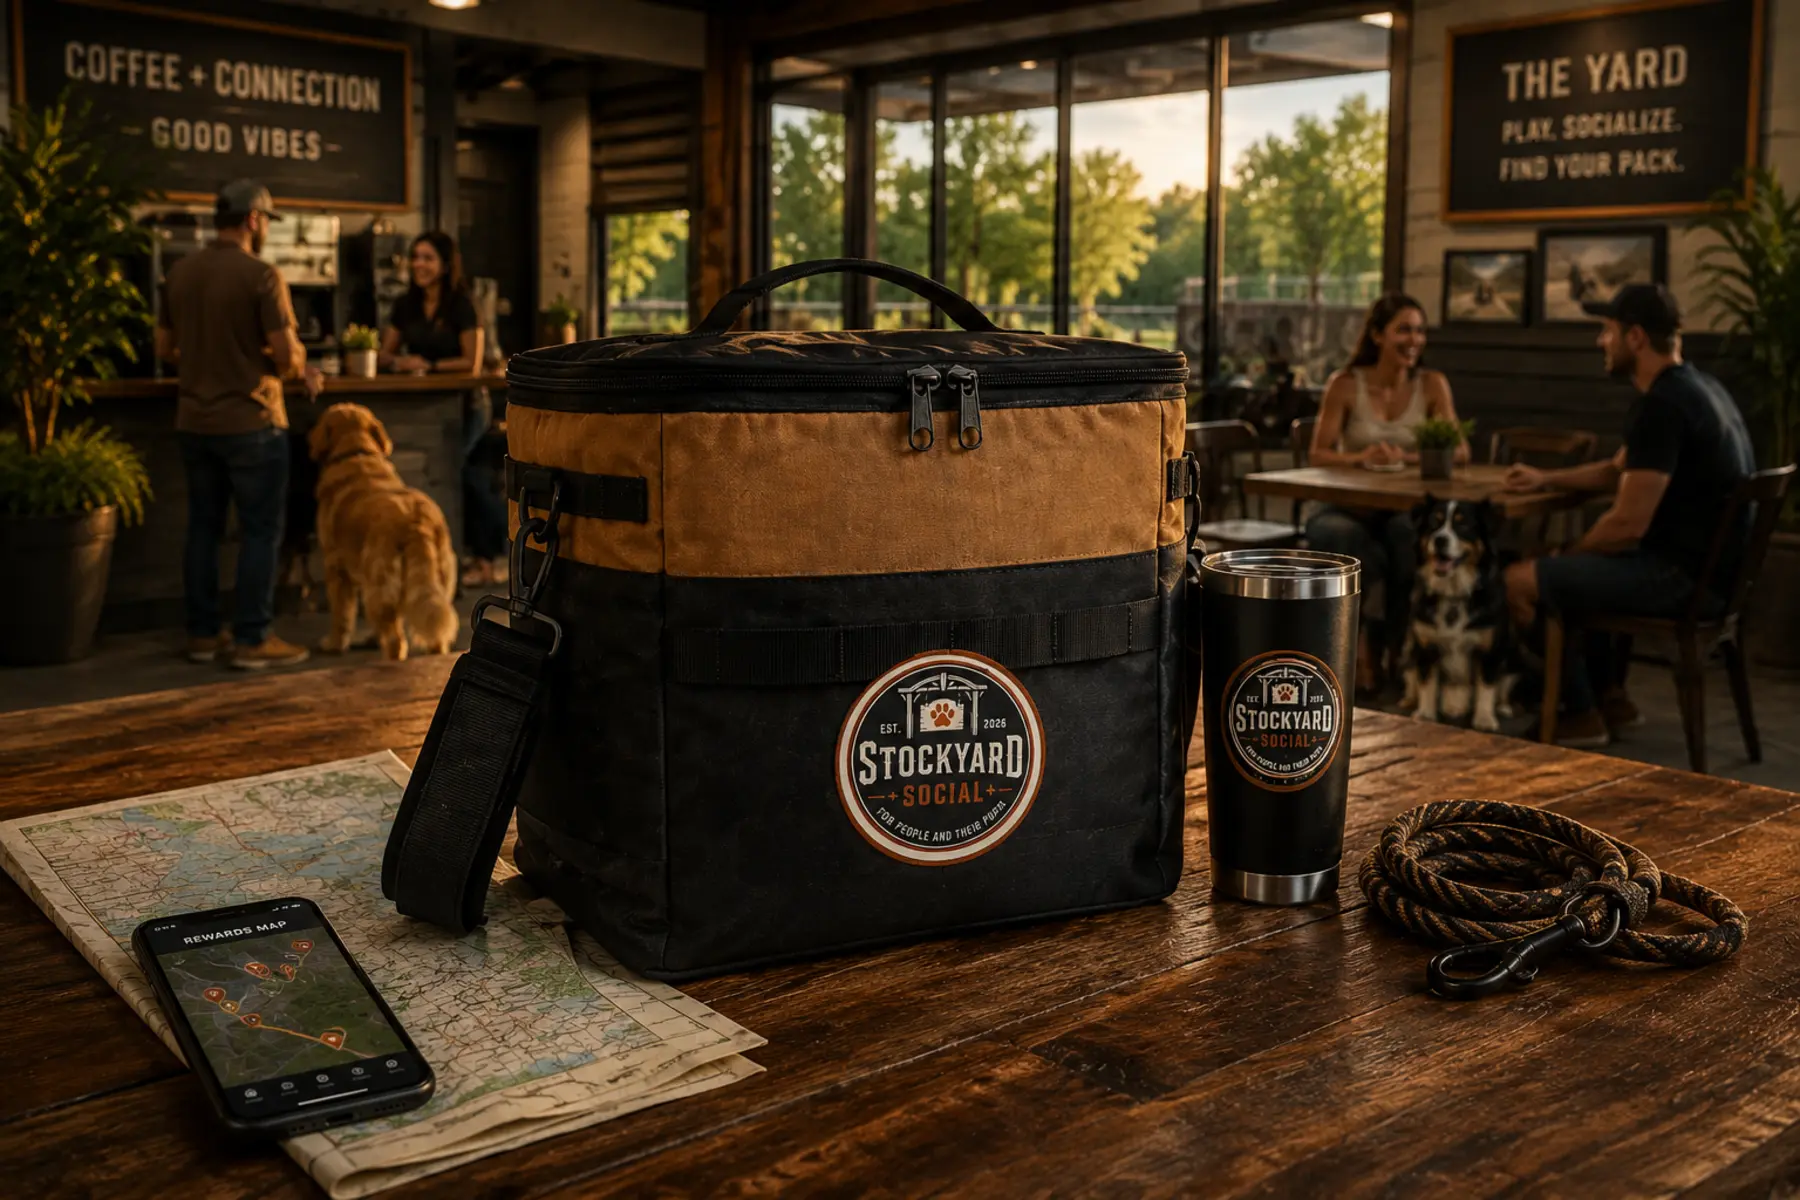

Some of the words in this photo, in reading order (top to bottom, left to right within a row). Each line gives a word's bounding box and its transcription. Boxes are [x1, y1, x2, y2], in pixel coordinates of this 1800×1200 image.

[64, 40, 183, 92] COFFEE
[213, 59, 382, 113] CONNECTION
[1502, 57, 1572, 102] THE
[1585, 44, 1689, 94] YARD
[152, 116, 232, 153] GOOD
[241, 124, 322, 161] VIBES
[1502, 117, 1557, 145] PLAY.
[1562, 107, 1684, 140] SOCIALIZE.
[1499, 155, 1549, 183] FIND
[1554, 151, 1612, 180] YOUR
[1618, 148, 1686, 177] PACK.
[880, 723, 901, 734] EST.
[983, 718, 1007, 729] 2026
[1235, 703, 1332, 732] STOCKYARD
[1261, 733, 1311, 748] SOCIAL
[858, 734, 1023, 786] STOCKYARD
[902, 780, 984, 807] SOCIAL
[876, 807, 896, 826] FOR
[894, 820, 930, 842] PEOPLE
[932, 831, 952, 842] AND
[183, 926, 253, 945] REWARDS
[256, 920, 287, 932] MAP
